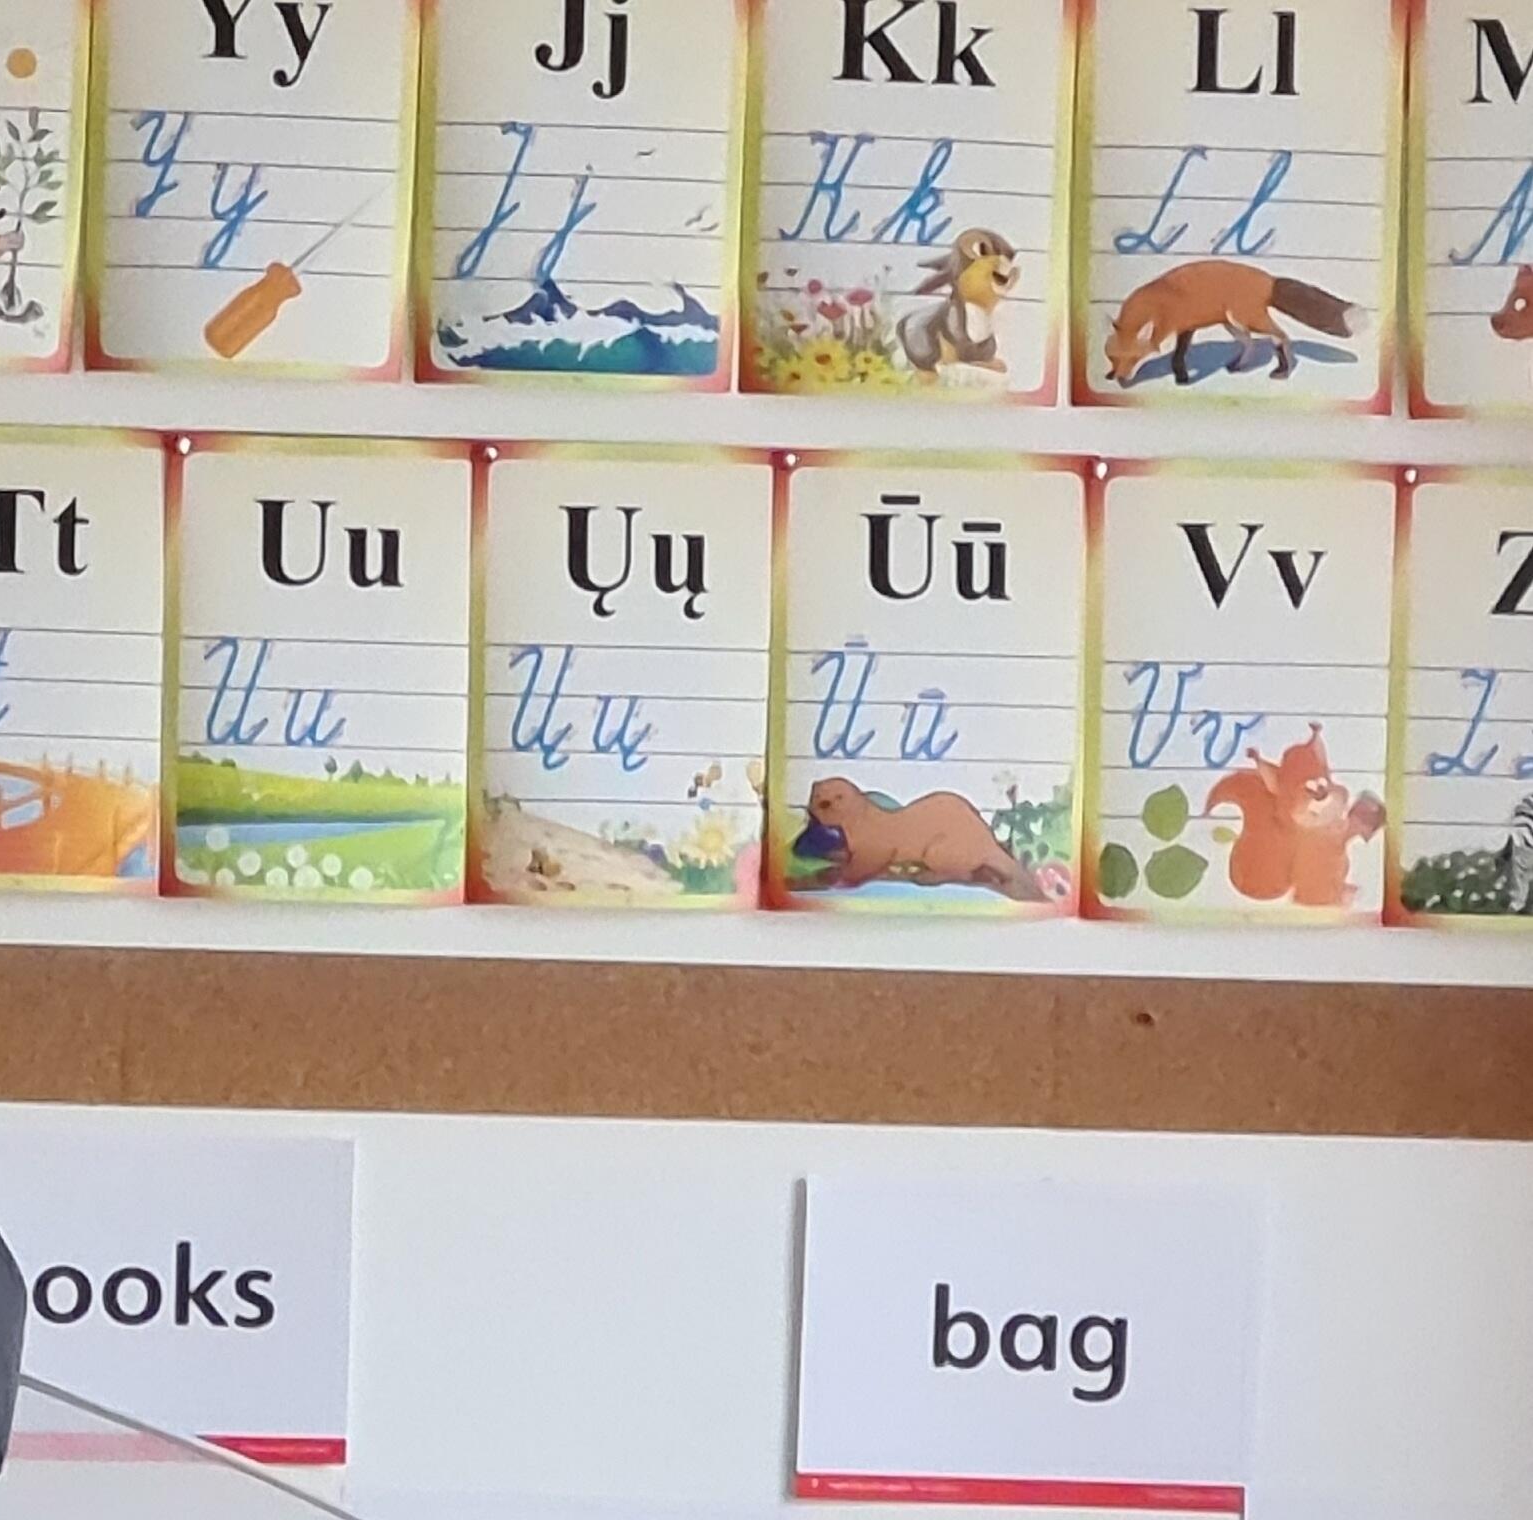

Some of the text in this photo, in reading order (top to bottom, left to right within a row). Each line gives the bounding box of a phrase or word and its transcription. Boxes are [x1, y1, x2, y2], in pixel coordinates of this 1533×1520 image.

[202, 0, 329, 88] Yy
[535, 0, 628, 99] Jj
[832, 0, 997, 87] Kk
[1187, 7, 1301, 97] Ll
[1465, 18, 1533, 103] M
[255, 498, 404, 588] Uu
[560, 505, 709, 618] Ųų
[861, 493, 1012, 602] Ūū
[1178, 522, 1329, 611] Vv
[1491, 530, 1533, 615] Z
[32, 1240, 275, 1329] ooks
[933, 1283, 1129, 1403] bag
